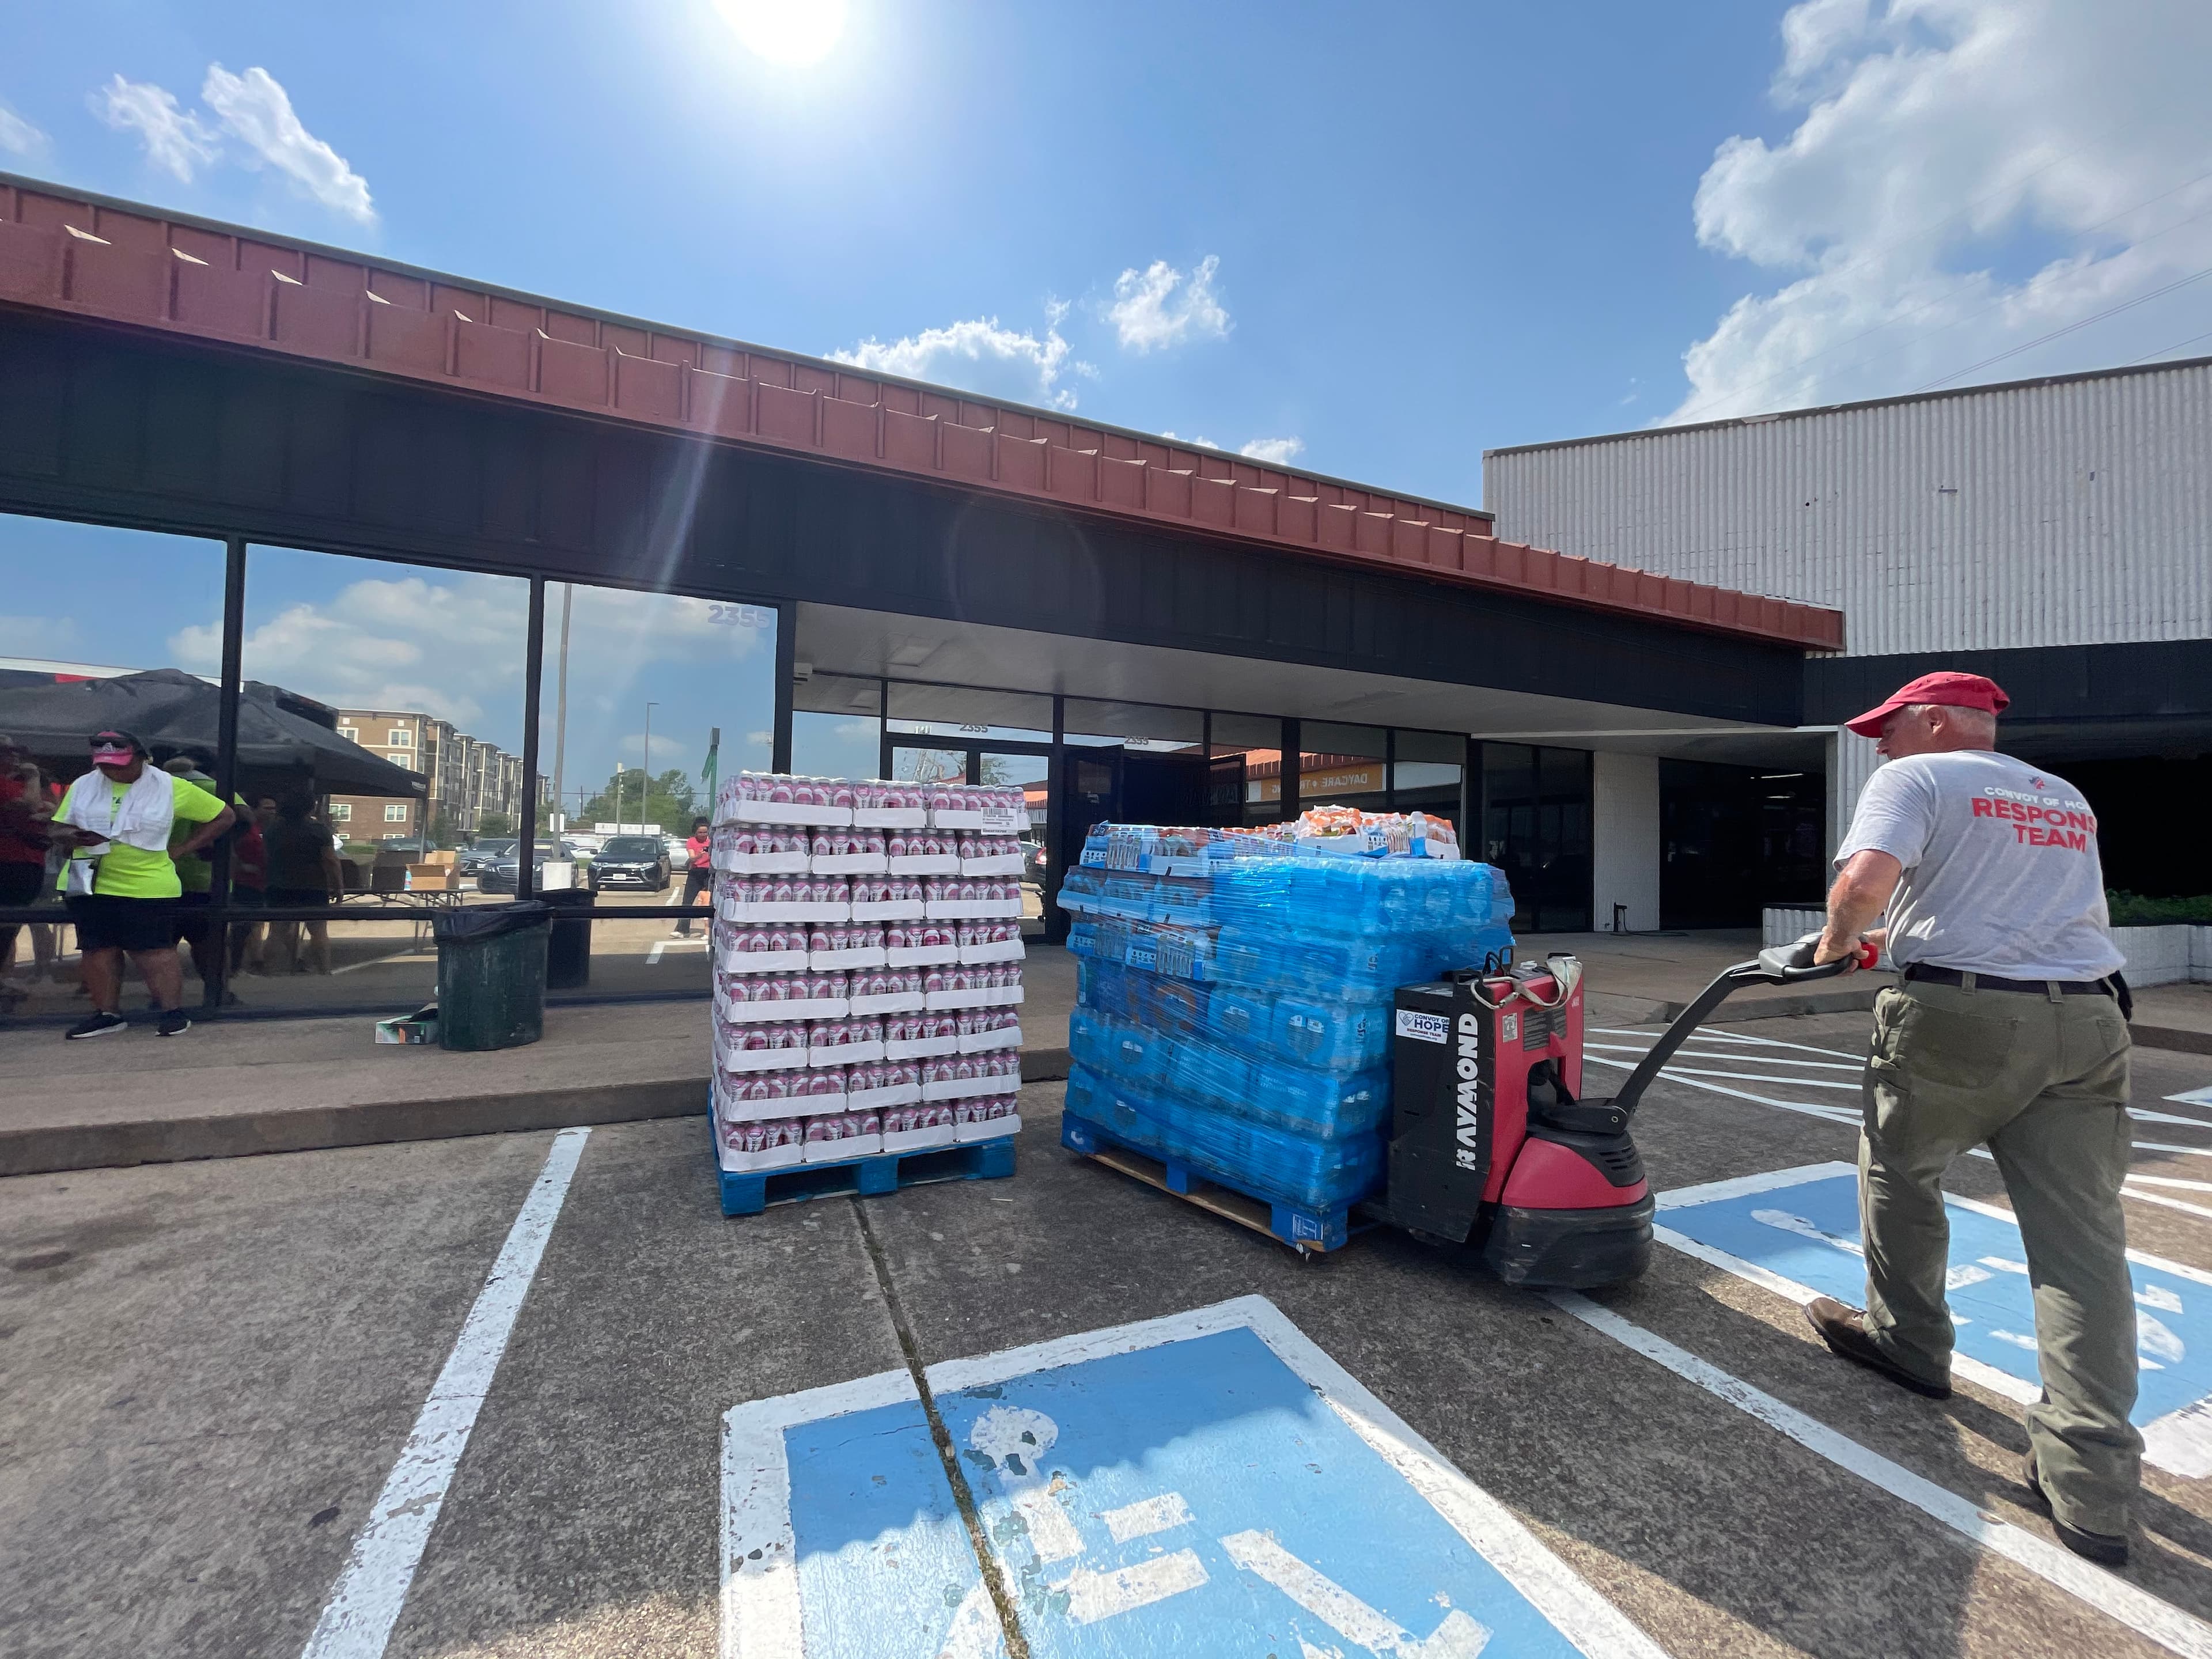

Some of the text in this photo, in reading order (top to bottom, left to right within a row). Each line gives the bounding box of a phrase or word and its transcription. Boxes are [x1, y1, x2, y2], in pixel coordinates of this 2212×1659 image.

[707, 604, 770, 628] 2355
[959, 722, 988, 733] 2355
[1124, 734, 1149, 745] 2355
[1984, 787, 2039, 804] CONVOY
[2043, 797, 2060, 806] OF
[2012, 823, 2087, 853] TEAM
[1415, 1019, 1449, 1033] HOPE
[1456, 1013, 1478, 1171] RAYMOND
